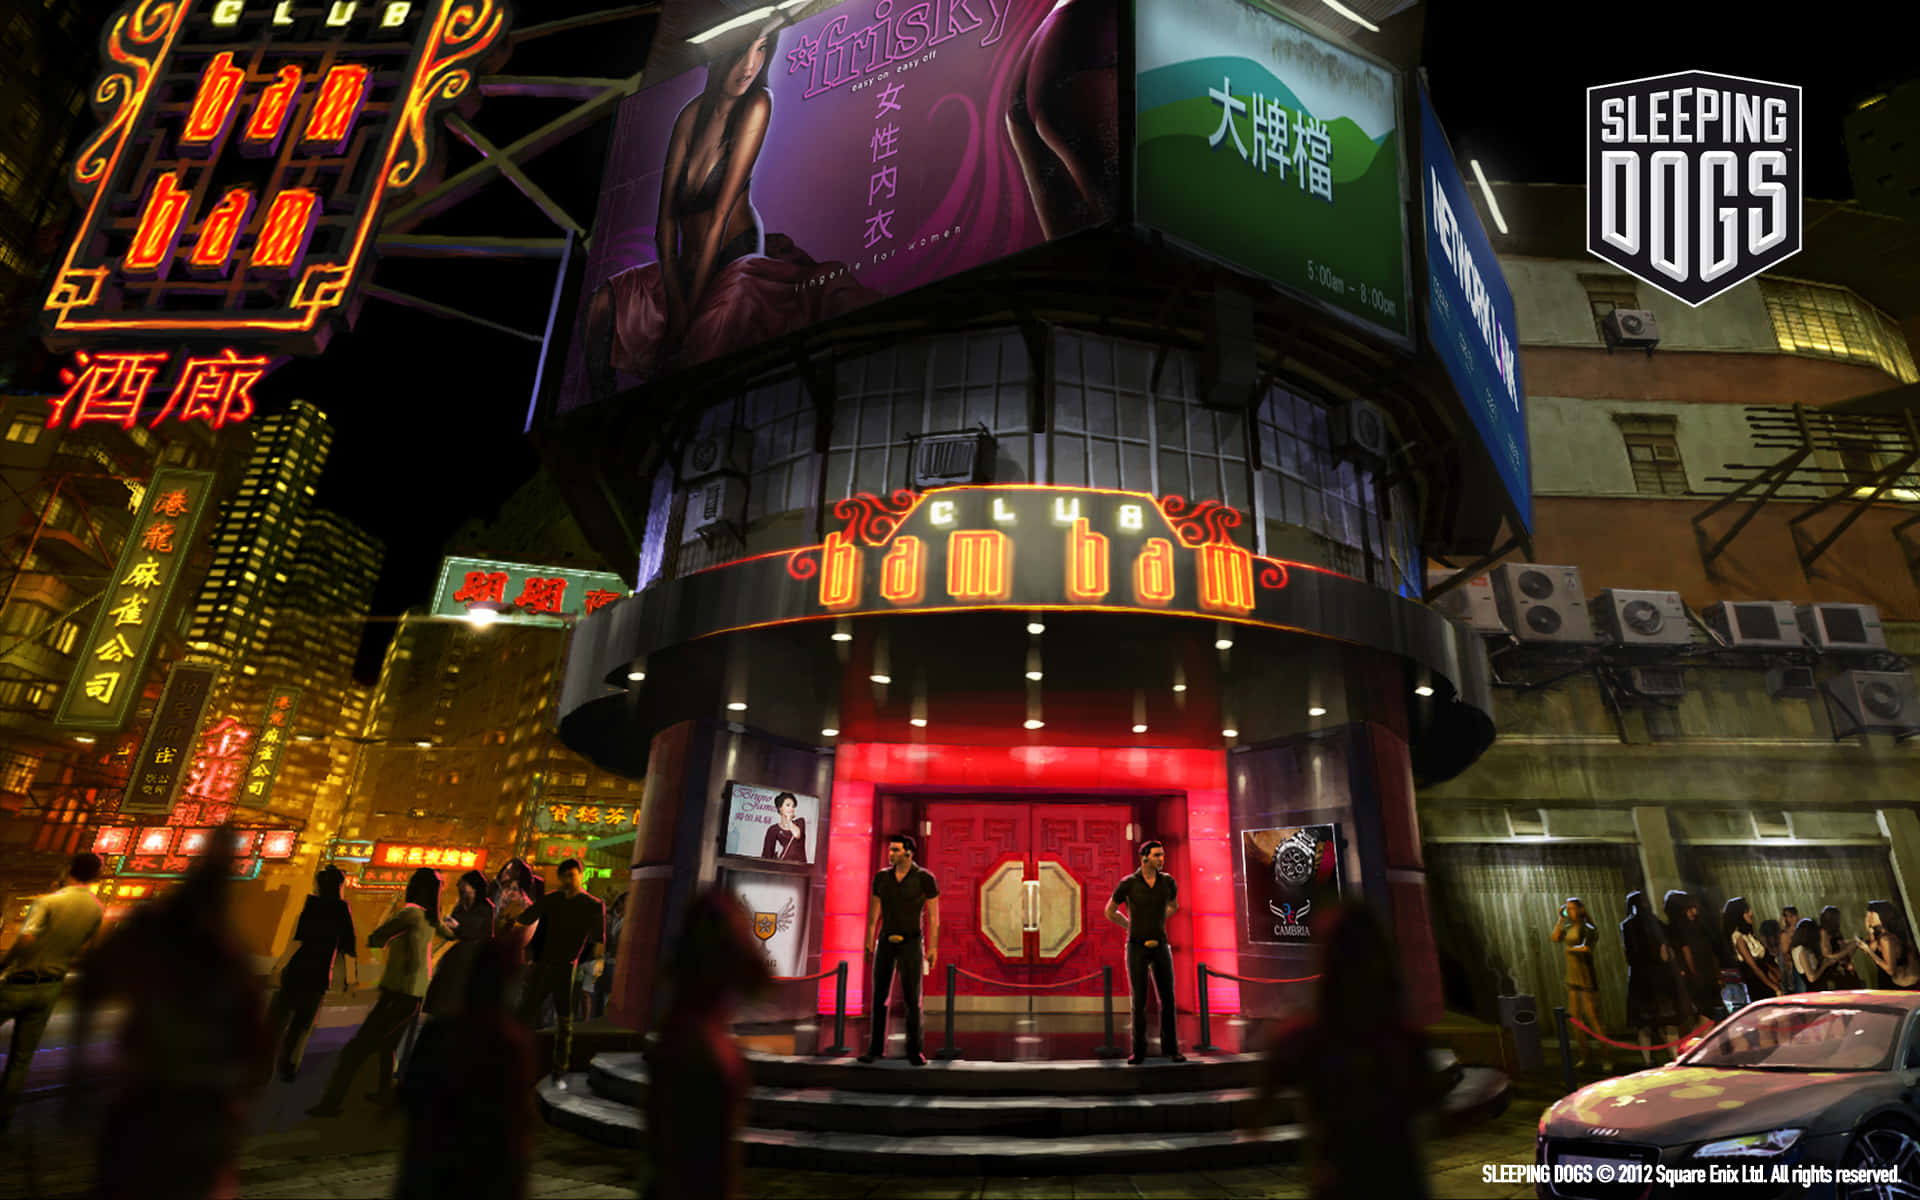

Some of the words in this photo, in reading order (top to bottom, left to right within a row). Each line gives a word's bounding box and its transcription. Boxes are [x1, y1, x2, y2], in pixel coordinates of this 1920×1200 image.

[211, 0, 411, 27] CLUB
[802, 0, 1011, 99] frisky
[178, 51, 370, 144] bam
[852, 77, 874, 92] easy
[877, 71, 889, 81] on
[896, 58, 920, 73] easy
[922, 50, 937, 63] off
[1208, 76, 1333, 202] 大牌檔
[122, 172, 318, 271] bam
[794, 260, 862, 293] lingerie
[873, 249, 896, 264] for
[907, 225, 962, 250] women
[1307, 259, 1344, 295] 5:00am
[1360, 281, 1398, 318] 8:00pm
[46, 348, 271, 430] 酒廊
[930, 497, 1143, 530] CLUB
[819, 529, 1010, 607] bam
[1068, 517, 1256, 611] bam
[1273, 924, 1311, 937] CAMBRIA
